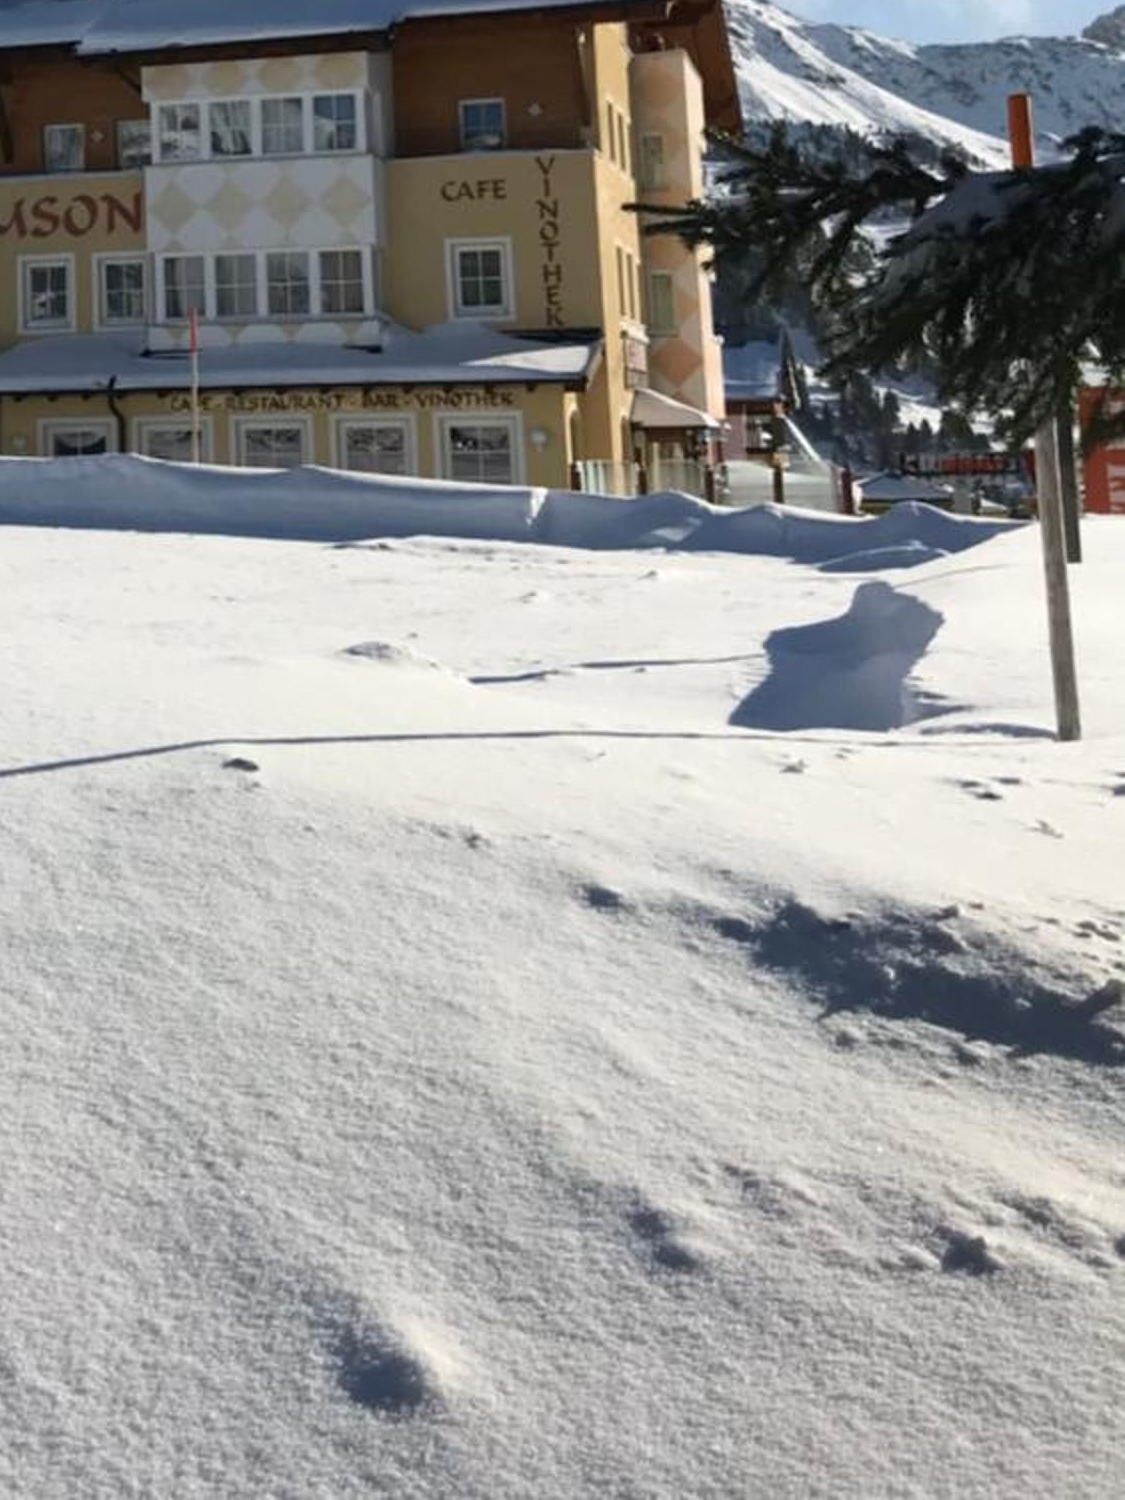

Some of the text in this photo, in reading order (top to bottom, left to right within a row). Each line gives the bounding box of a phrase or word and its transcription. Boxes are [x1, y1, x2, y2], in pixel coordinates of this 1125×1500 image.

[440, 179, 507, 201] CAFE
[535, 156, 564, 326] VINOTHEK
[171, 394, 212, 411] CAE
[415, 391, 514, 408] VINOTHEK
